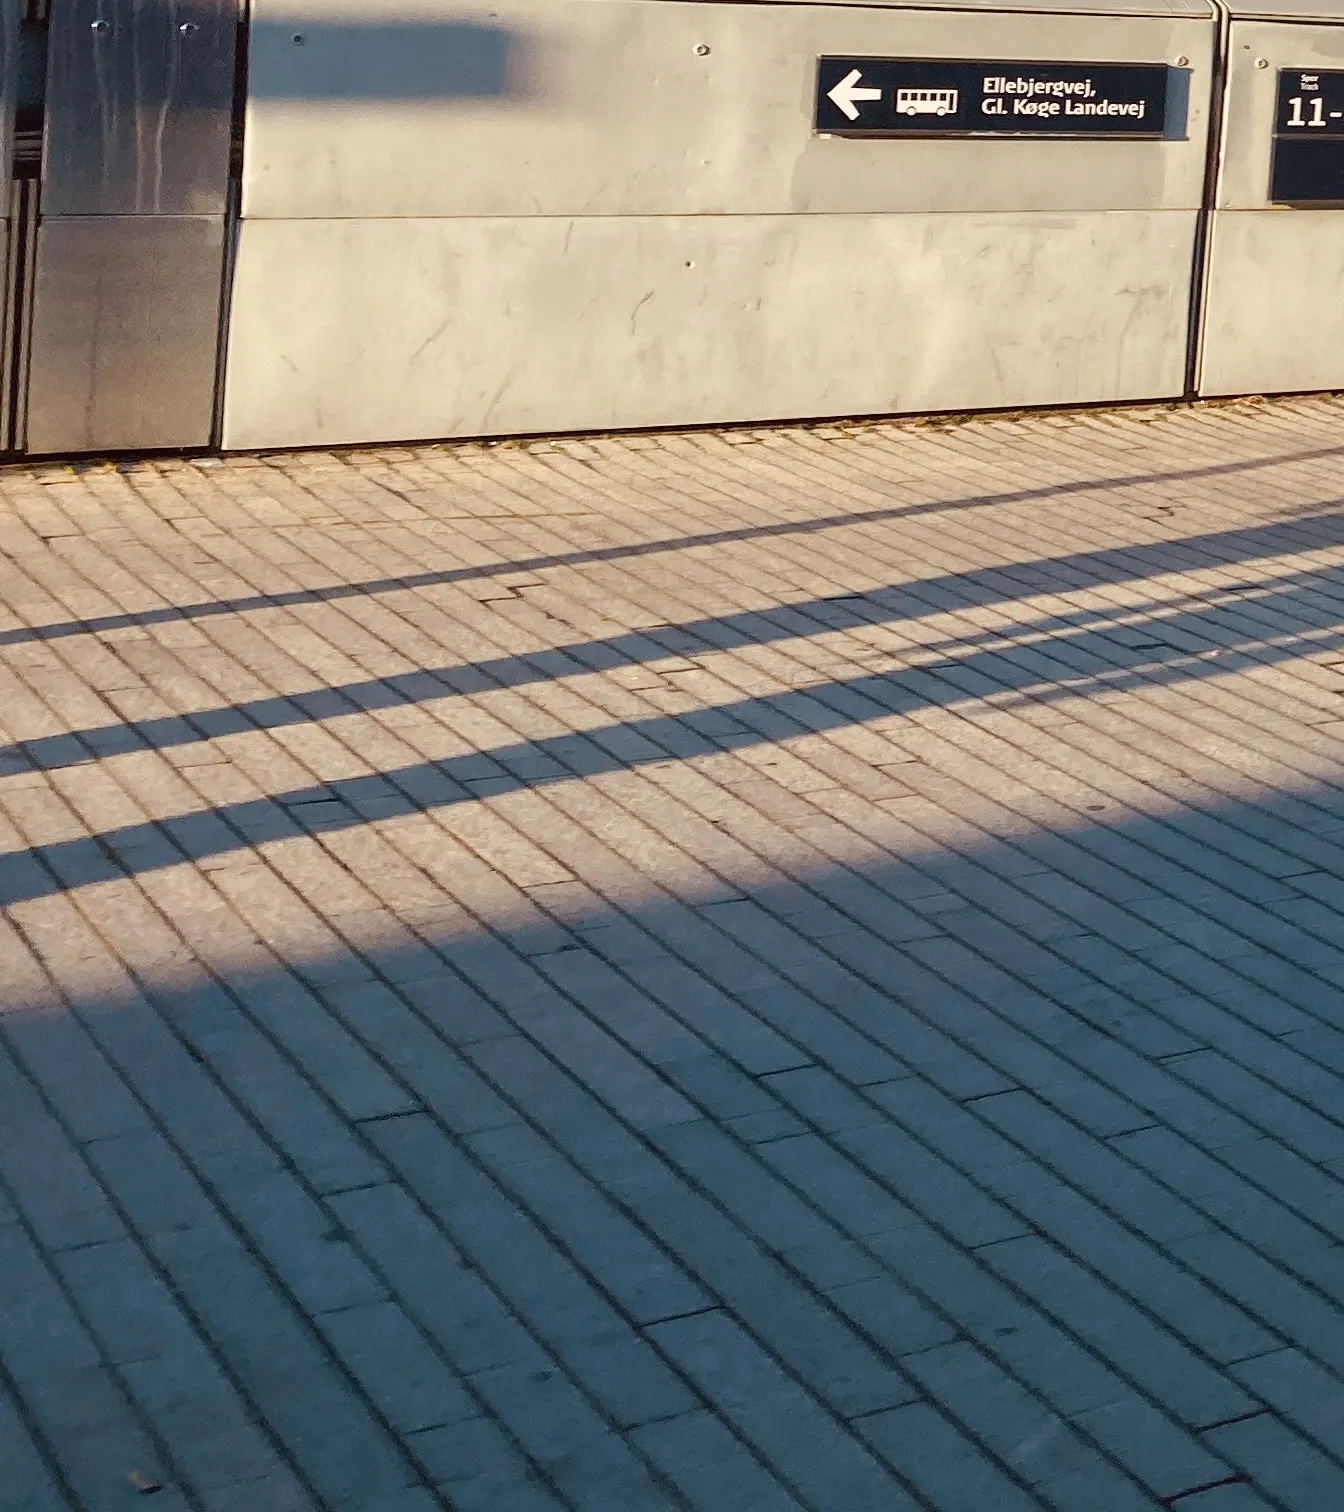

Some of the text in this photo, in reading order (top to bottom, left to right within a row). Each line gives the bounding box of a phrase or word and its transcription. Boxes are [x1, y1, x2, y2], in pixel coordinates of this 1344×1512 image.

[983, 77, 1097, 97] Ellebjergvej,
[981, 98, 1145, 119] Gl. Køge Landevej
